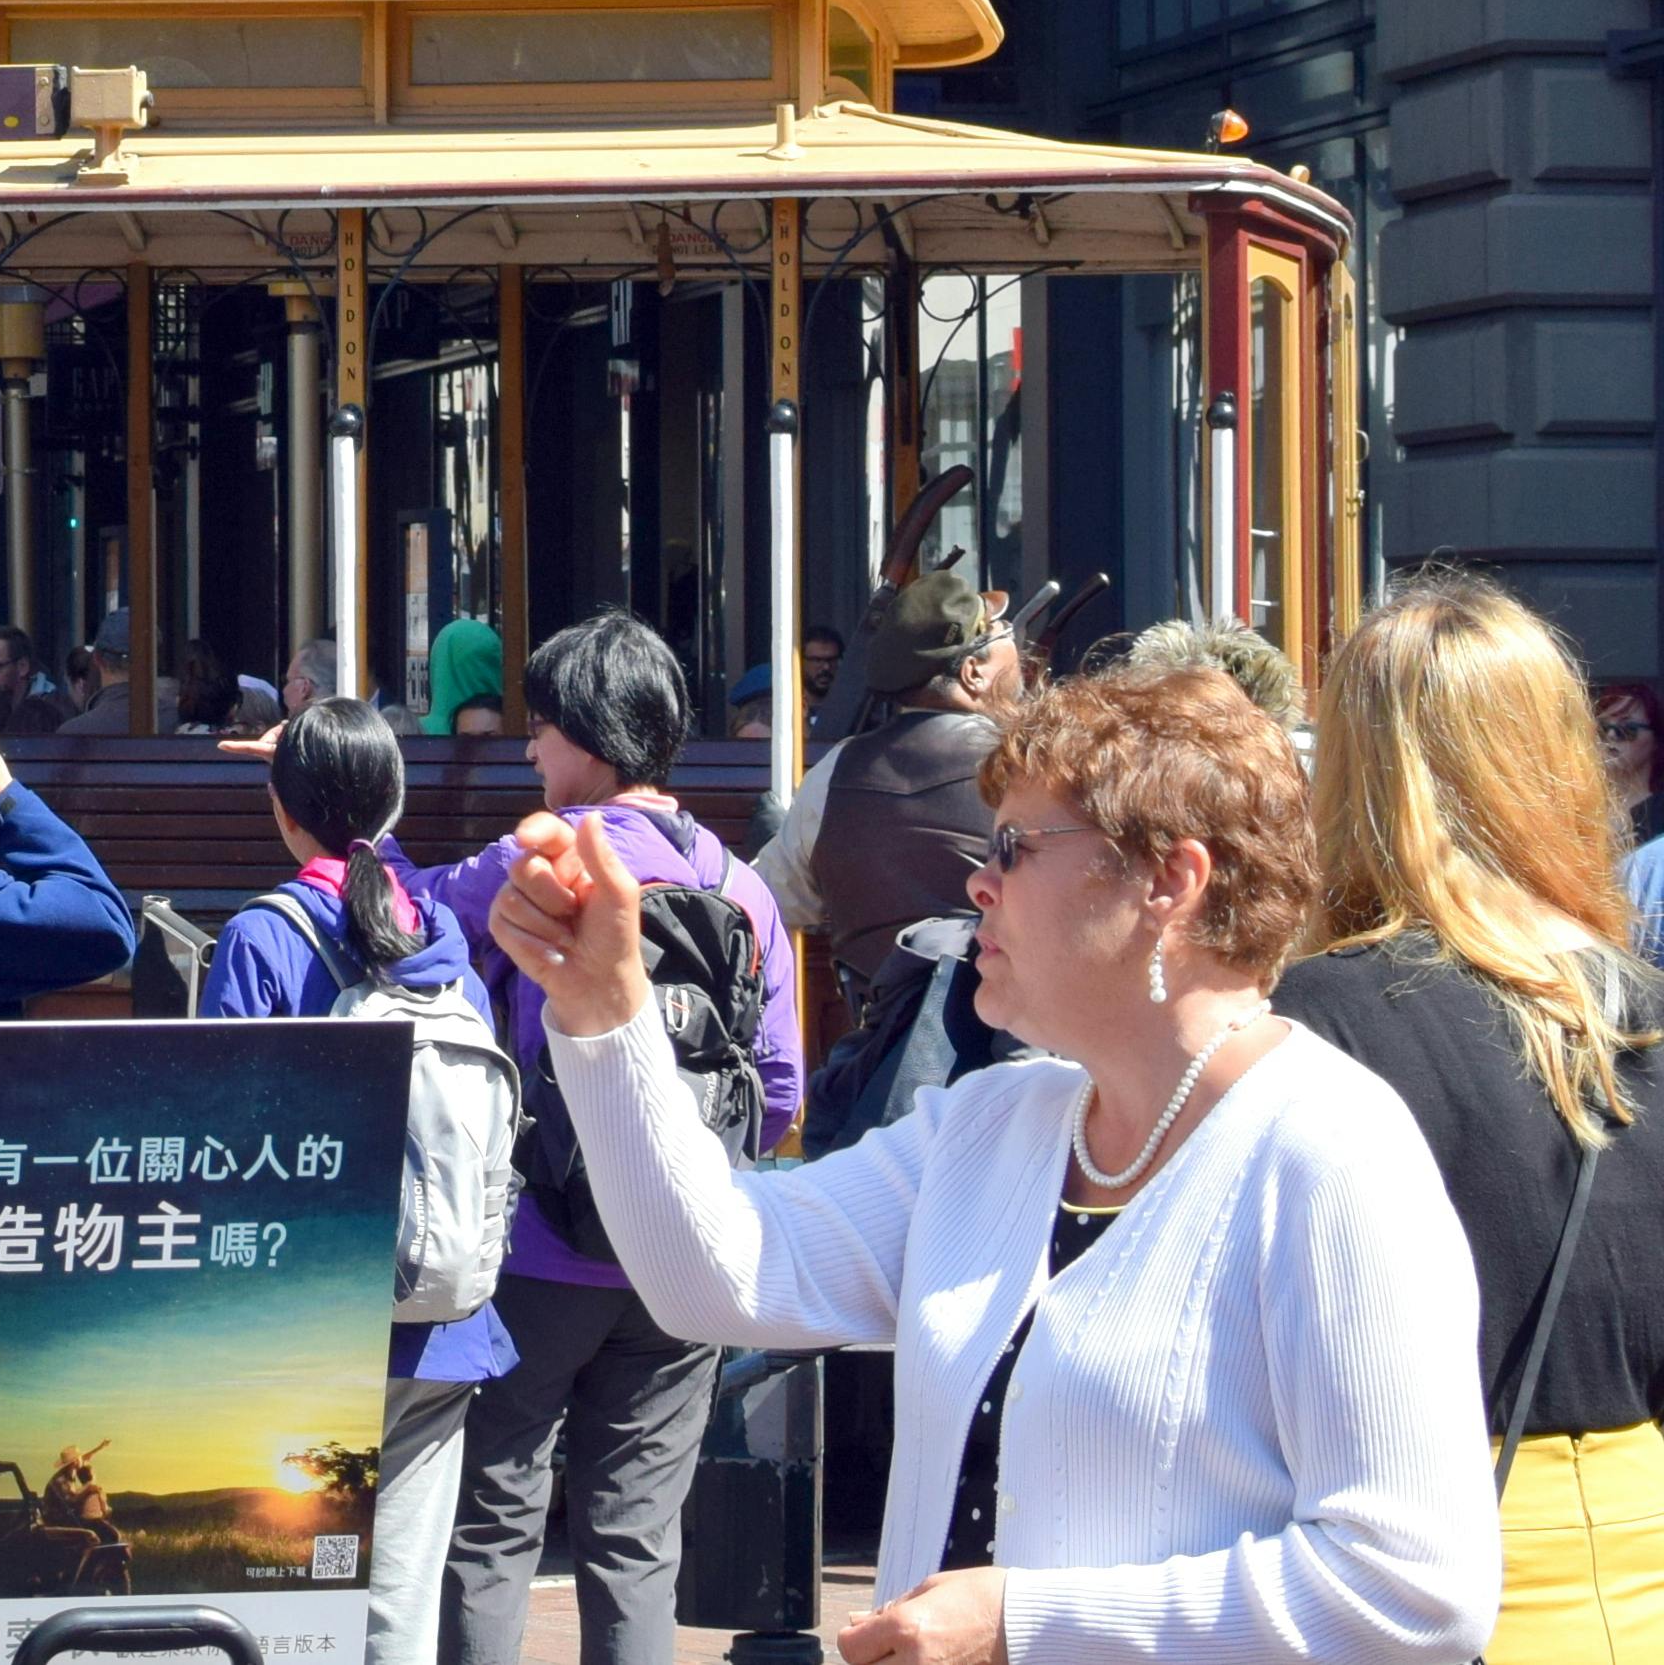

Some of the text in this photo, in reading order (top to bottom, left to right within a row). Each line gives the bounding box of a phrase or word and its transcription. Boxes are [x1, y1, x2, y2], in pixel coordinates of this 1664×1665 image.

[344, 232, 357, 381] HOLD ON
[780, 225, 792, 376] HOLD ON
